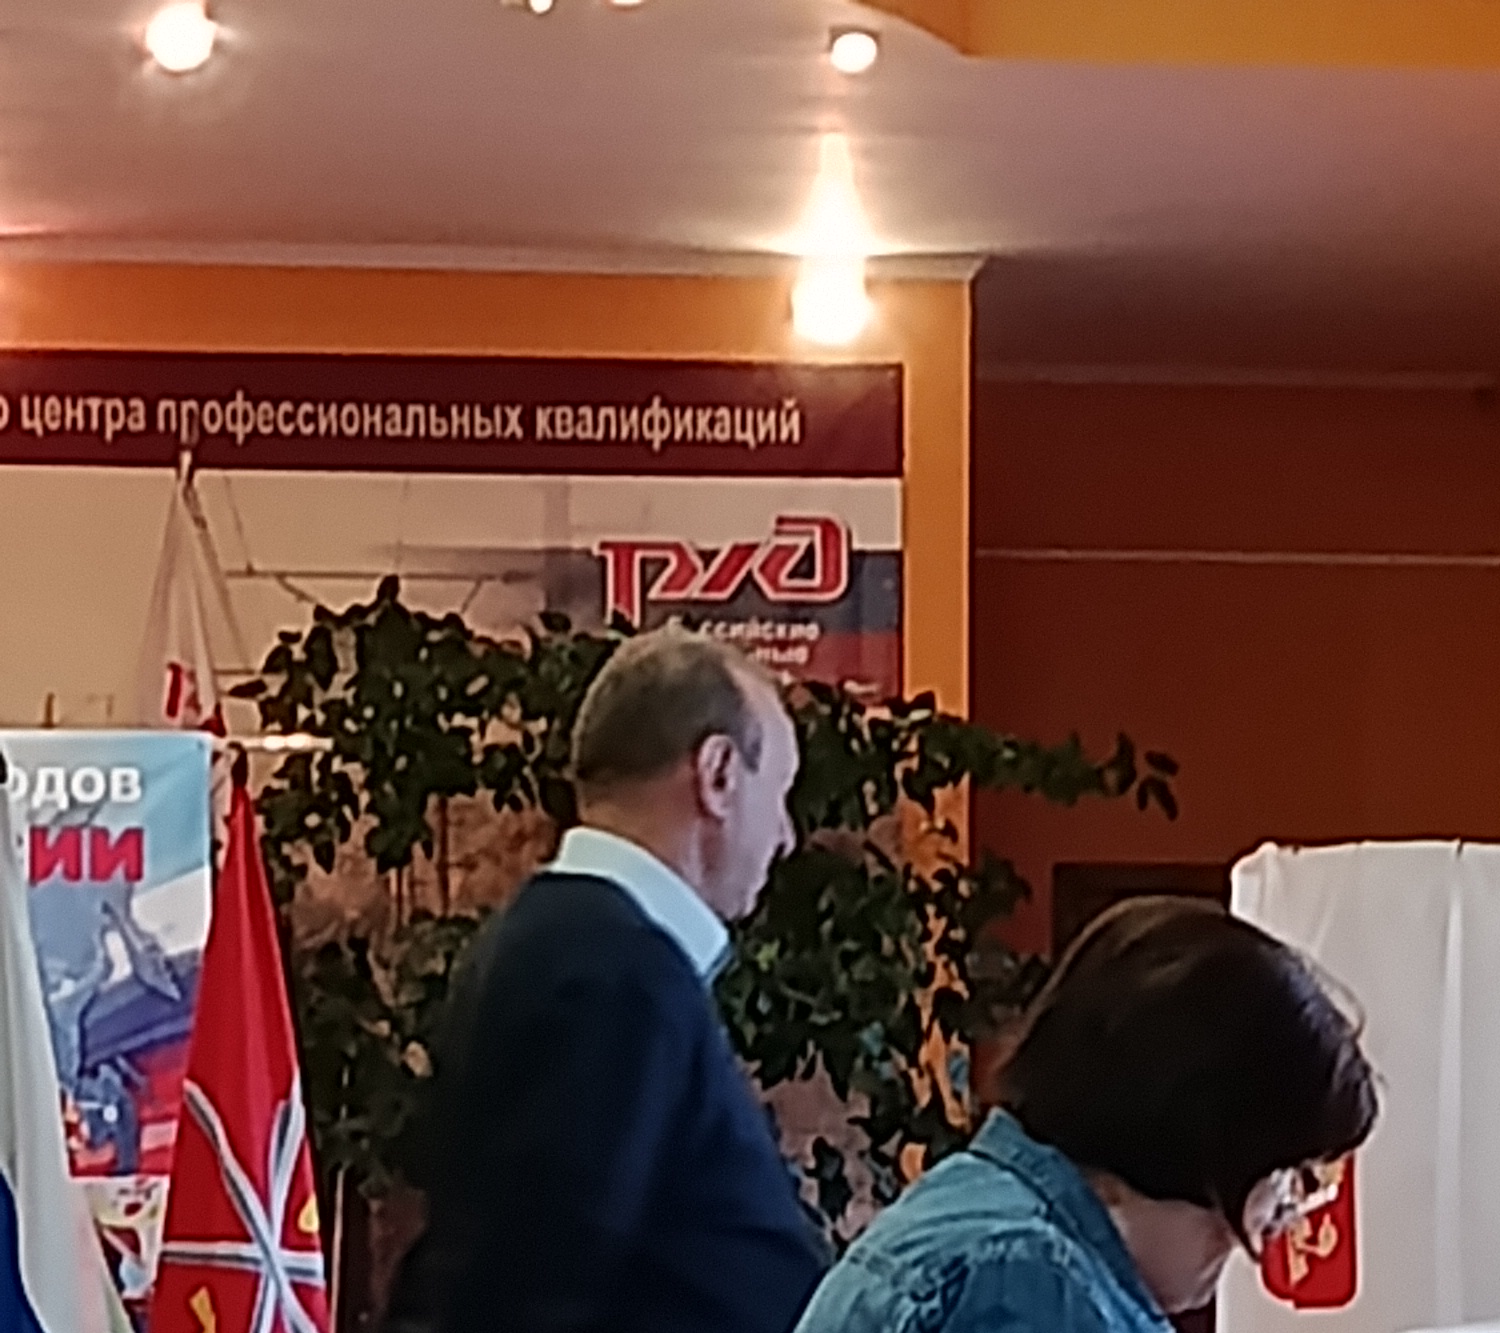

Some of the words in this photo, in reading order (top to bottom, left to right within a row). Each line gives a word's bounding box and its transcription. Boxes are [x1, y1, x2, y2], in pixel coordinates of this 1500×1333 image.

[20, 394, 147, 443] центра
[156, 389, 524, 446] профессиональных
[535, 396, 801, 451] квалификаций
